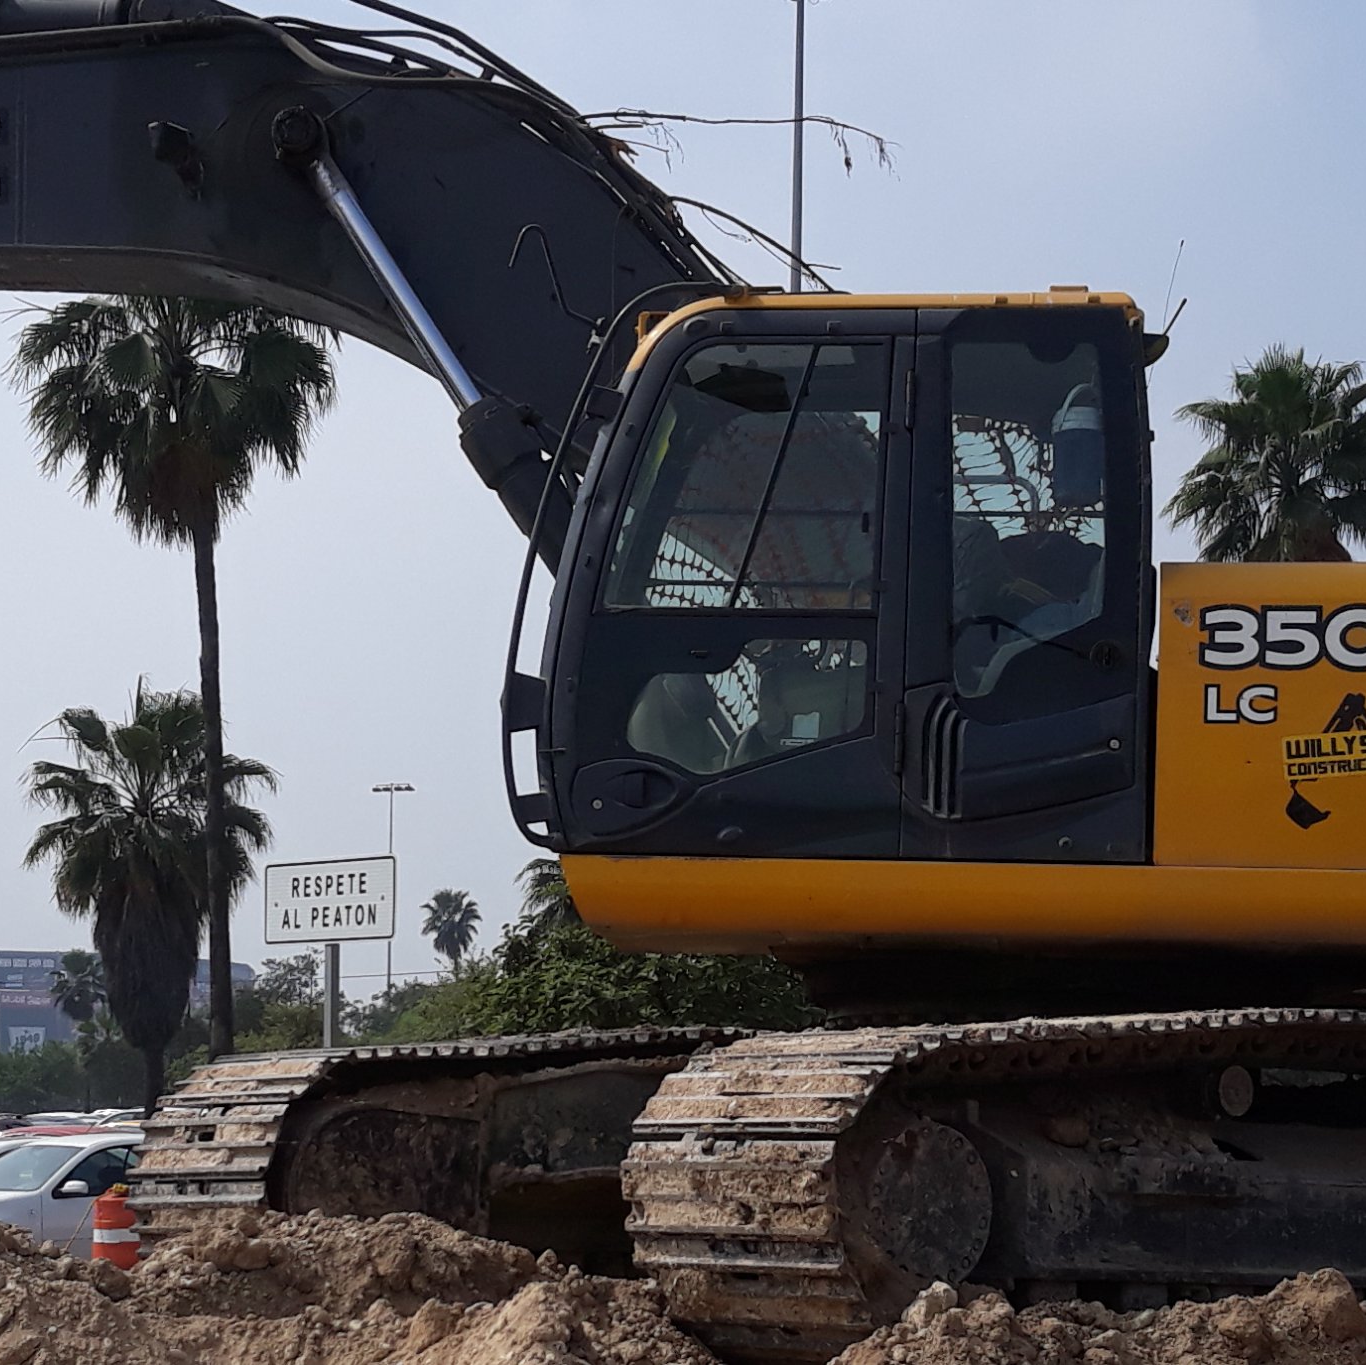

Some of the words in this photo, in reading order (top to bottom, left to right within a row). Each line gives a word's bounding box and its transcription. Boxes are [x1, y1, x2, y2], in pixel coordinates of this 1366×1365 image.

[1205, 684, 1277, 724] LC
[292, 873, 367, 898] RESPETE
[282, 909, 301, 929] AL
[311, 904, 377, 928] PEATON
